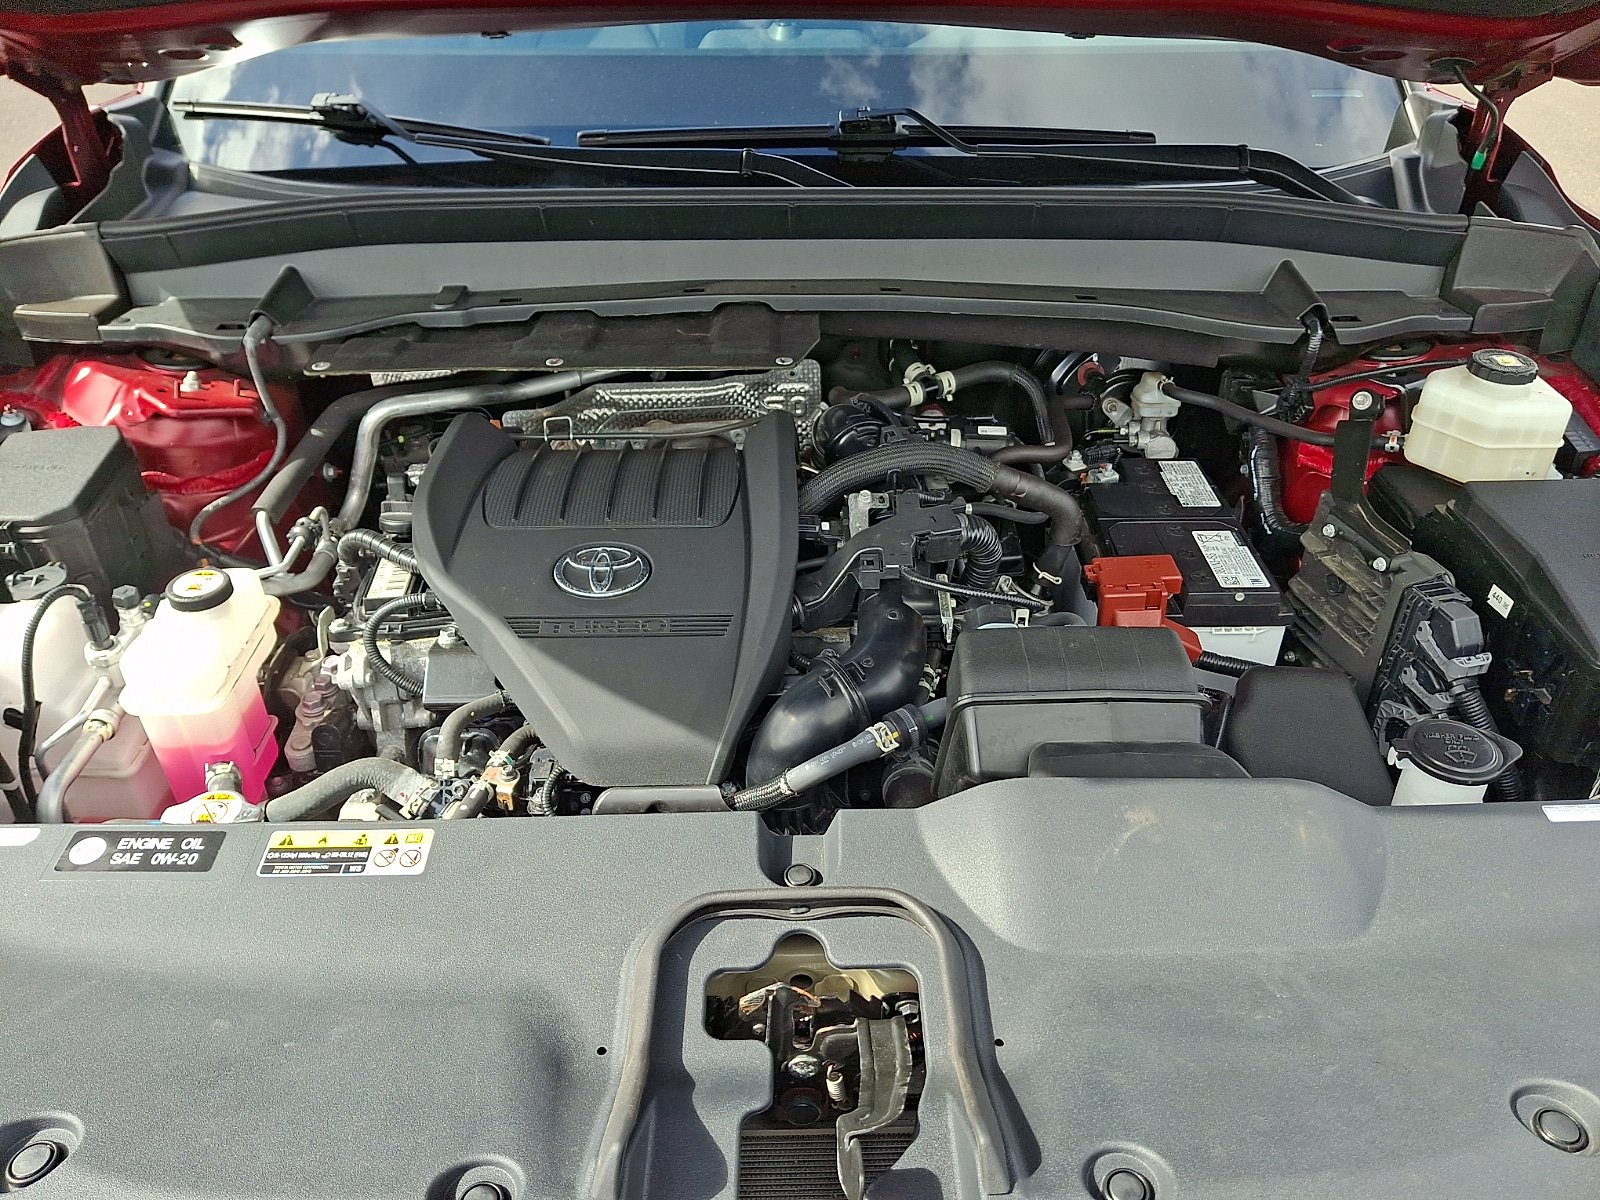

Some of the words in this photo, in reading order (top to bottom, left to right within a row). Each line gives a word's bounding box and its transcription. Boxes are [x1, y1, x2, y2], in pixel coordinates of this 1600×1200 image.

[543, 618, 669, 634] TURBO
[117, 837, 175, 850] ENGINE
[181, 837, 205, 850] OIL
[109, 852, 143, 865] SAE
[150, 852, 199, 865] 0W-20
